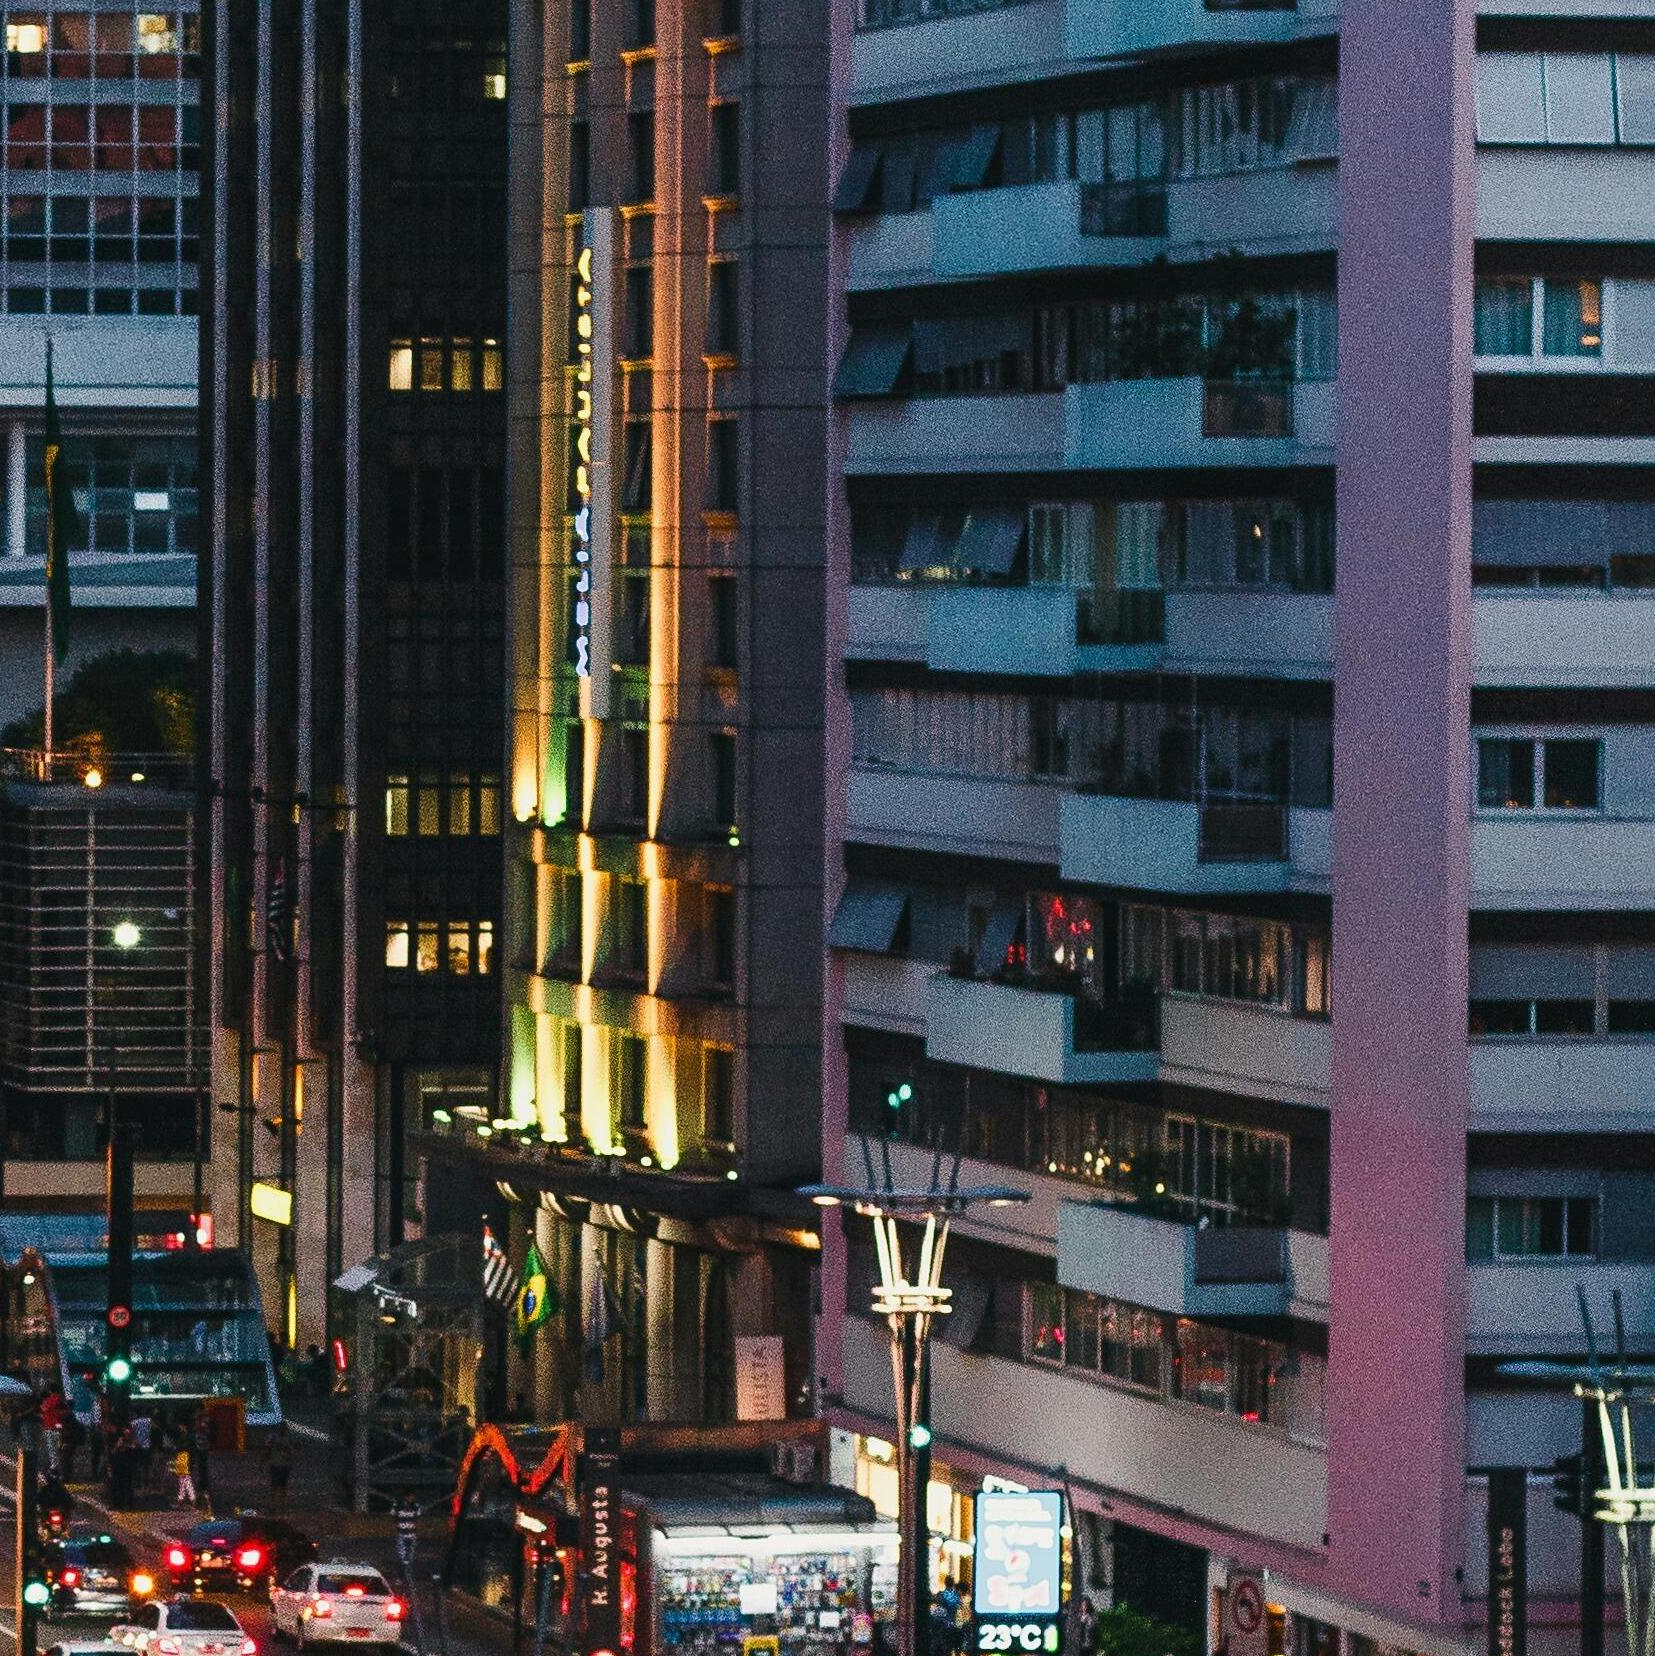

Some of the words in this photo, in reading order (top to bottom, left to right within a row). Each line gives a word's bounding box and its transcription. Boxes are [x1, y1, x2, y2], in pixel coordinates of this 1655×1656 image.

[591, 1486, 613, 1579] Augusta
[1496, 1527, 1515, 1581] Lobo
[978, 1623, 1042, 1651] 23°C
